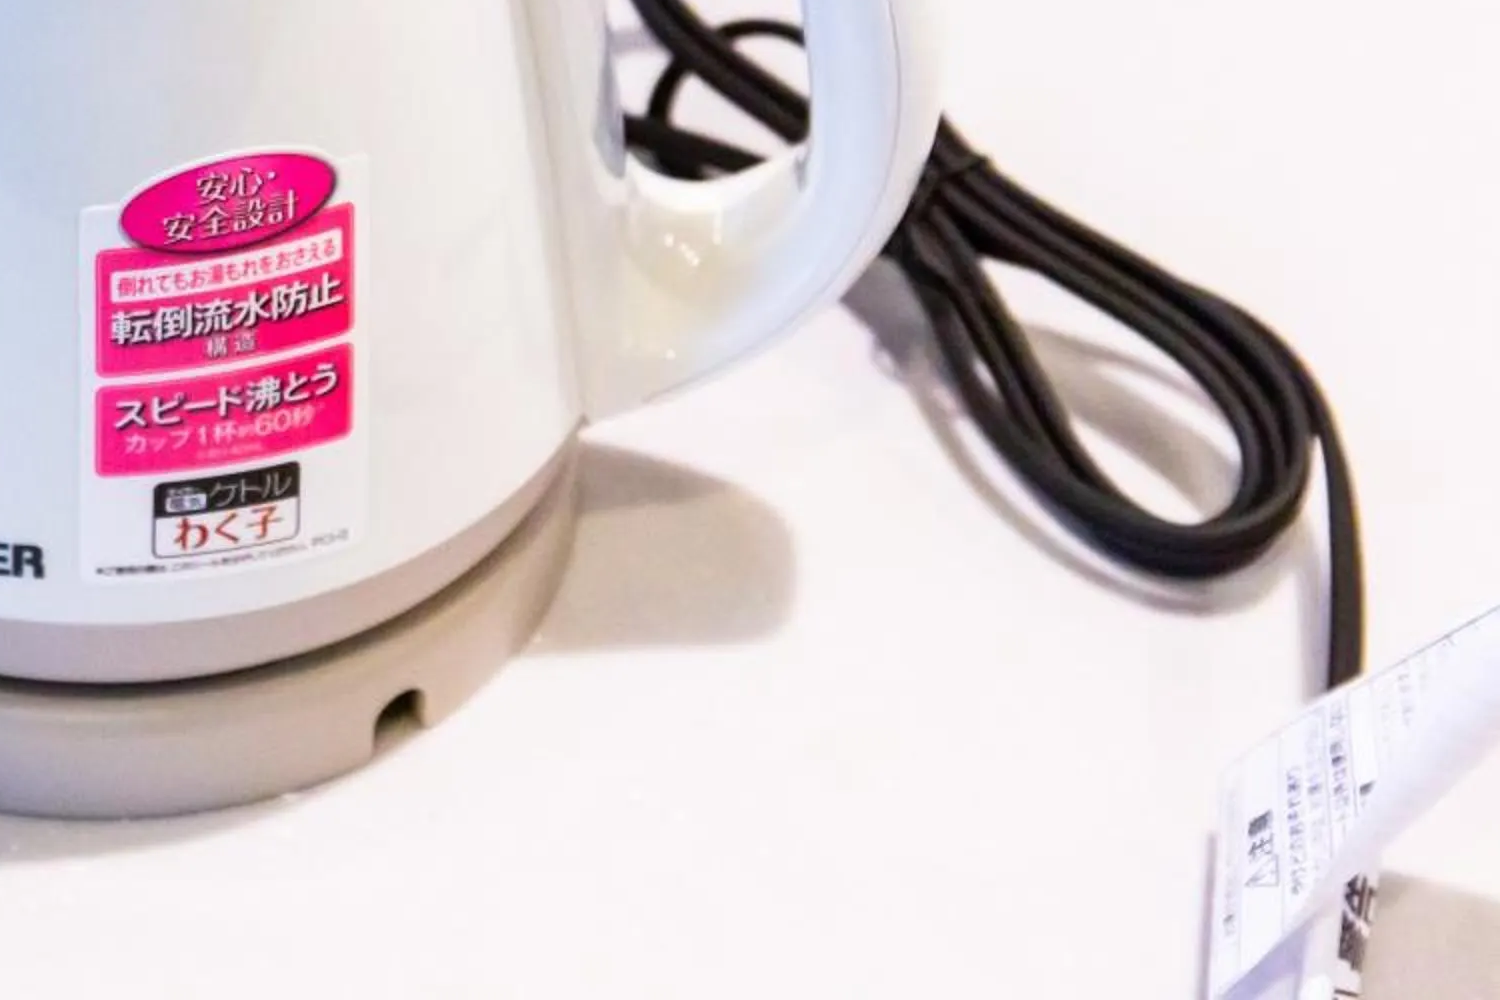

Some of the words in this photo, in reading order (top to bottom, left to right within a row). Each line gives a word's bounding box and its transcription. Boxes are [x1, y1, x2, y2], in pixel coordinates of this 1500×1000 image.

[163, 189, 299, 245] 安全設計
[111, 271, 344, 346] 転倒流水防止
[113, 362, 339, 430] スピード沸とう
[173, 505, 283, 551] わく子
